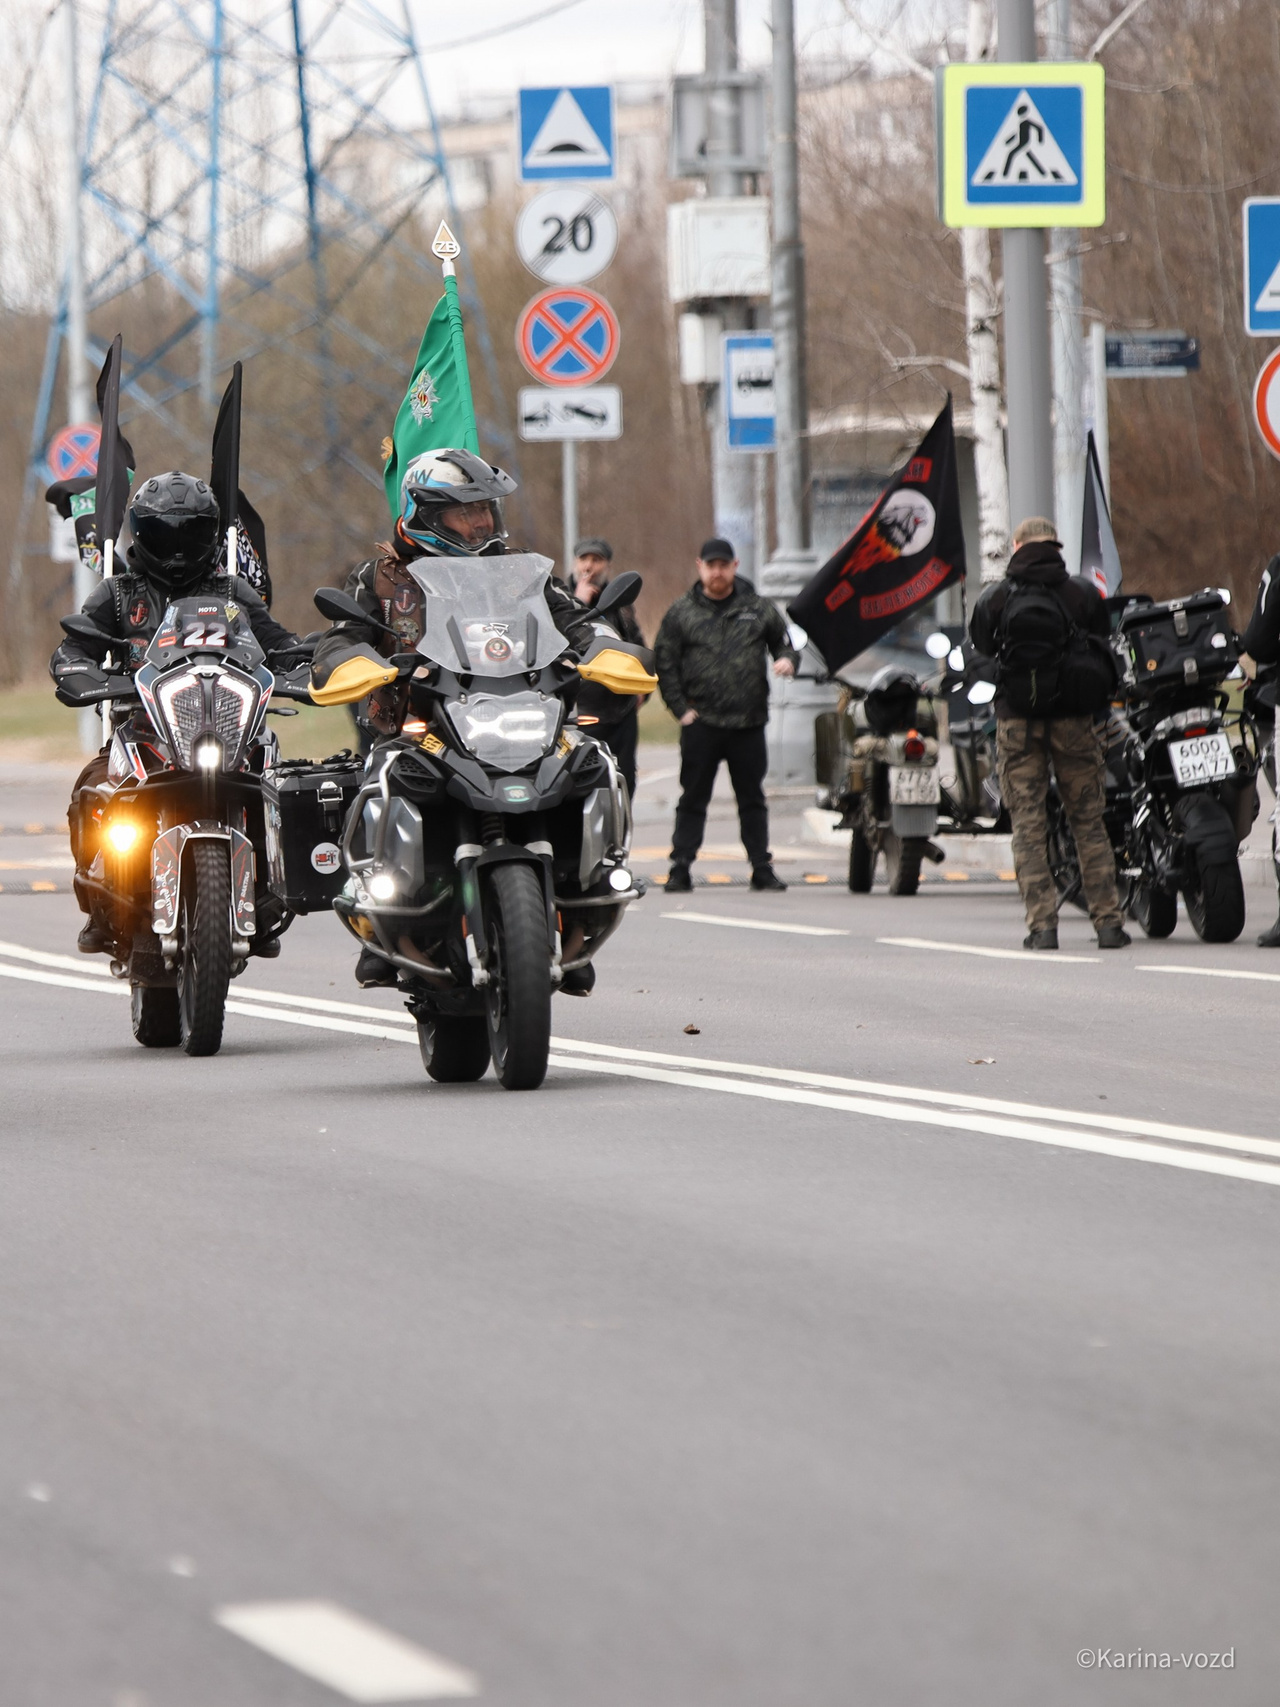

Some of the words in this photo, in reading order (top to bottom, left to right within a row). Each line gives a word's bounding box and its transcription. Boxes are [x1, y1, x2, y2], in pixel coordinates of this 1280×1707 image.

[543, 216, 592, 252] 20
[183, 622, 227, 647] 22
[1180, 739, 1221, 758] 6000
[1209, 756, 1229, 775] 77
